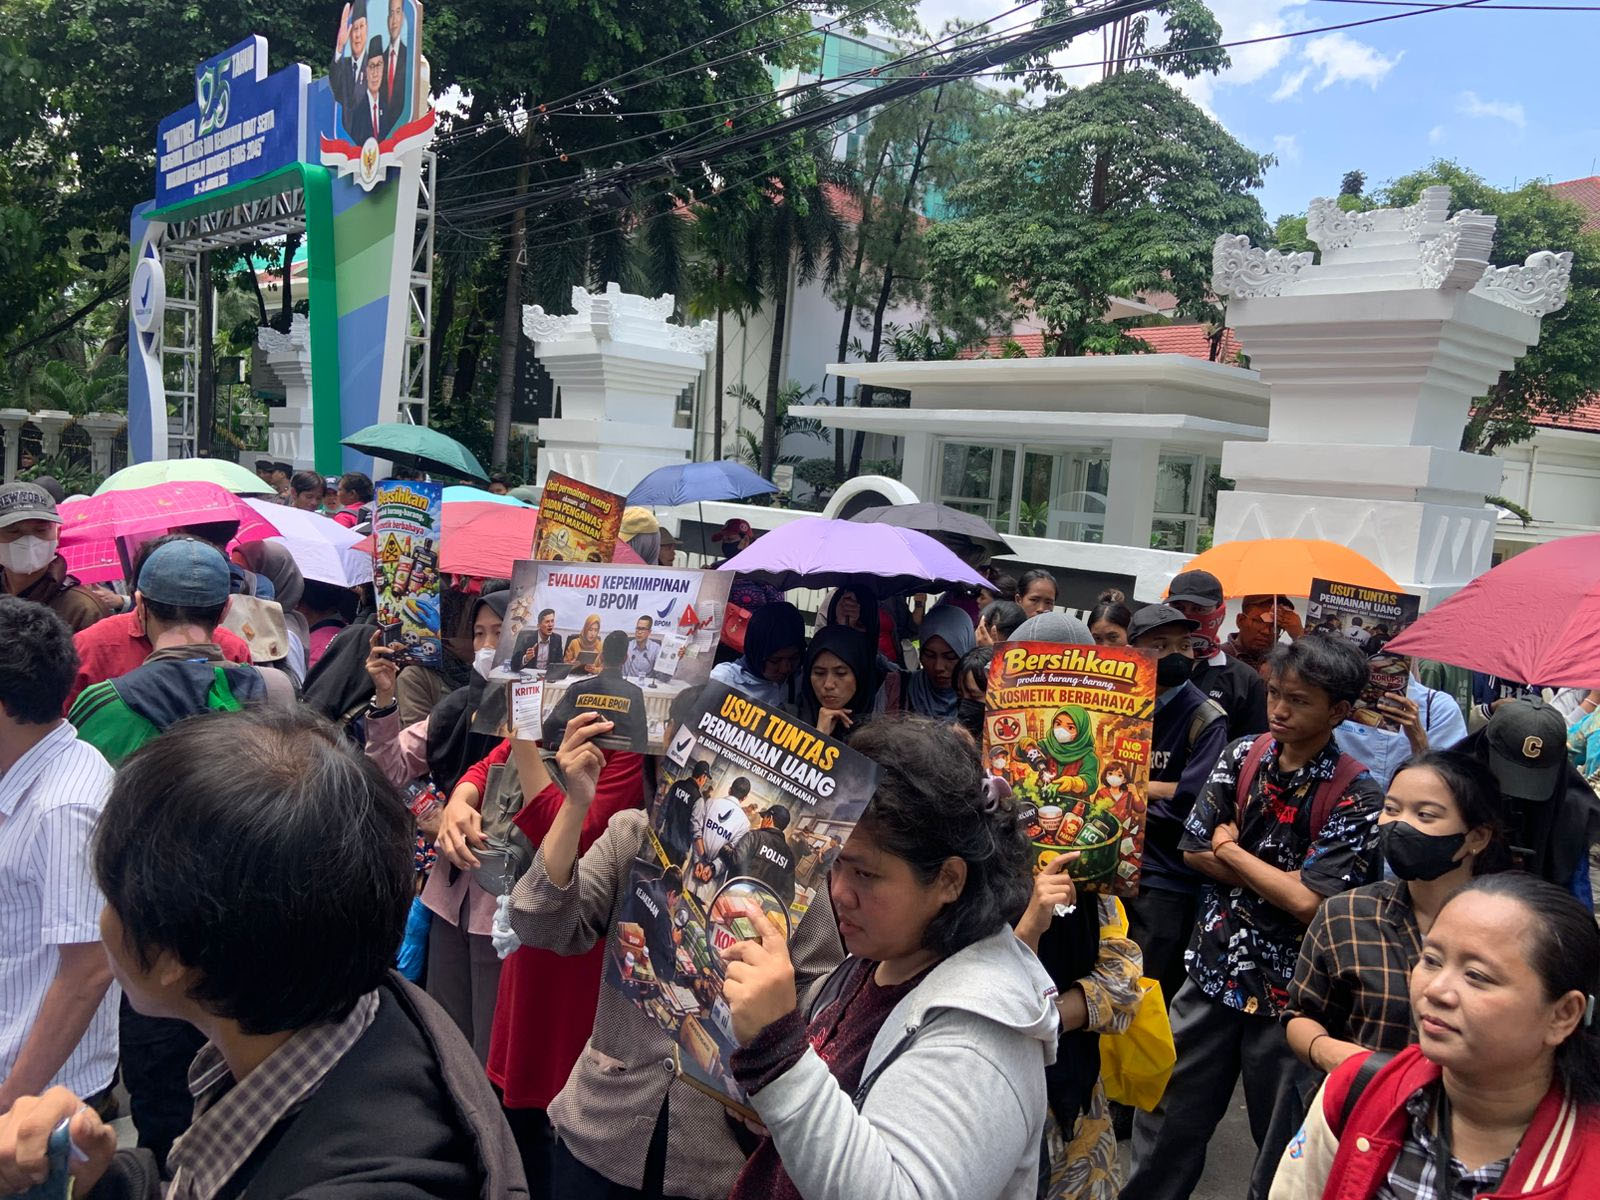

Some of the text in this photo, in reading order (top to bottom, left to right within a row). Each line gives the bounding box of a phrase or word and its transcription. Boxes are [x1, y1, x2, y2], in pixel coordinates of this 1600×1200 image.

[562, 503, 603, 529] PENGAWAS
[590, 497, 612, 514] uang
[565, 517, 601, 540] MAKANAN
[548, 573, 690, 593] EVALUASI KEPEMIMPINAN
[1329, 583, 1397, 605] USUT TUNTAS
[586, 592, 639, 610] DI BPOM
[1320, 593, 1402, 616] PERMAINAN UANG
[1004, 648, 1135, 679] Bersihkan
[1016, 673, 1046, 687] produk
[1371, 675, 1404, 684] KORUPSI
[515, 686, 540, 697] KRITIK
[1000, 689, 1135, 712] KOSMETIK BERBAHAYA
[577, 695, 630, 711] KEPALA BPOM
[720, 694, 840, 771] USUT TUNTAS
[698, 712, 836, 797] PERMAINAN UANG
[1118, 748, 1144, 761] TOXIC
[1122, 740, 1142, 752] NO
[1522, 735, 1543, 758] C
[702, 737, 721, 754] BADAN
[720, 748, 751, 770] PENGAWAS
[751, 764, 767, 777] OBAT
[766, 772, 782, 786] DAN
[781, 781, 818, 806] MAKANAN
[674, 787, 691, 804] KPK
[705, 818, 733, 841] BPOM
[760, 845, 789, 869] POLISI
